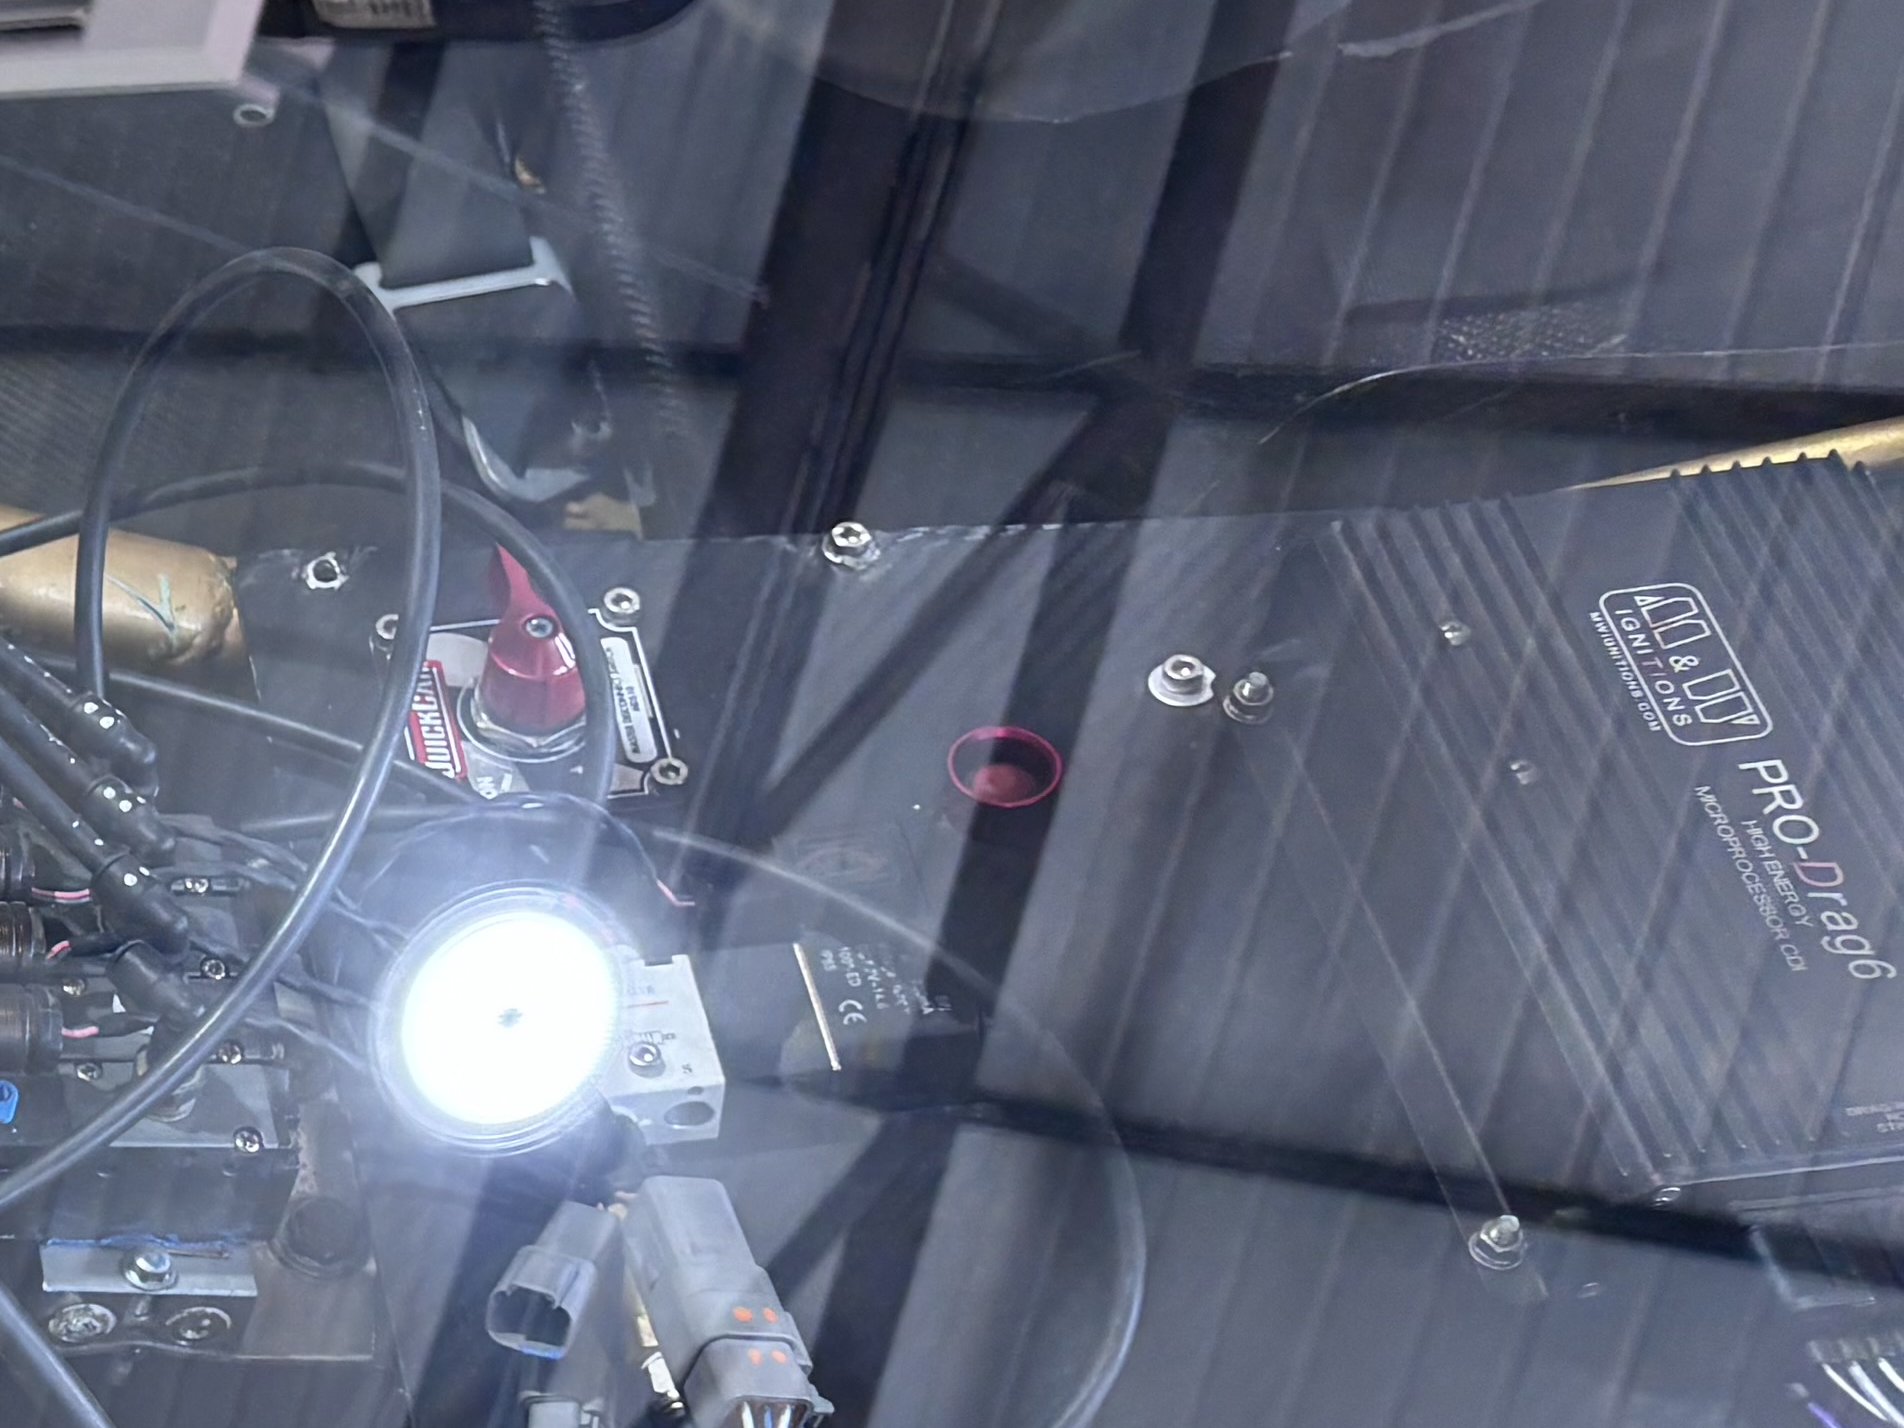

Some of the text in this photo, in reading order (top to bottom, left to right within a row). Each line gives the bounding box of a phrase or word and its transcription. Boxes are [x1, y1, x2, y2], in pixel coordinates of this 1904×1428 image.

[1614, 608, 1693, 728] IGNITIONS
[1668, 654, 1700, 674] &
[1693, 784, 1793, 942] MICROPROCESSOR
[1738, 758, 1898, 980] PRO-Drag6
[1740, 818, 1815, 930] HIGH ENERGY
